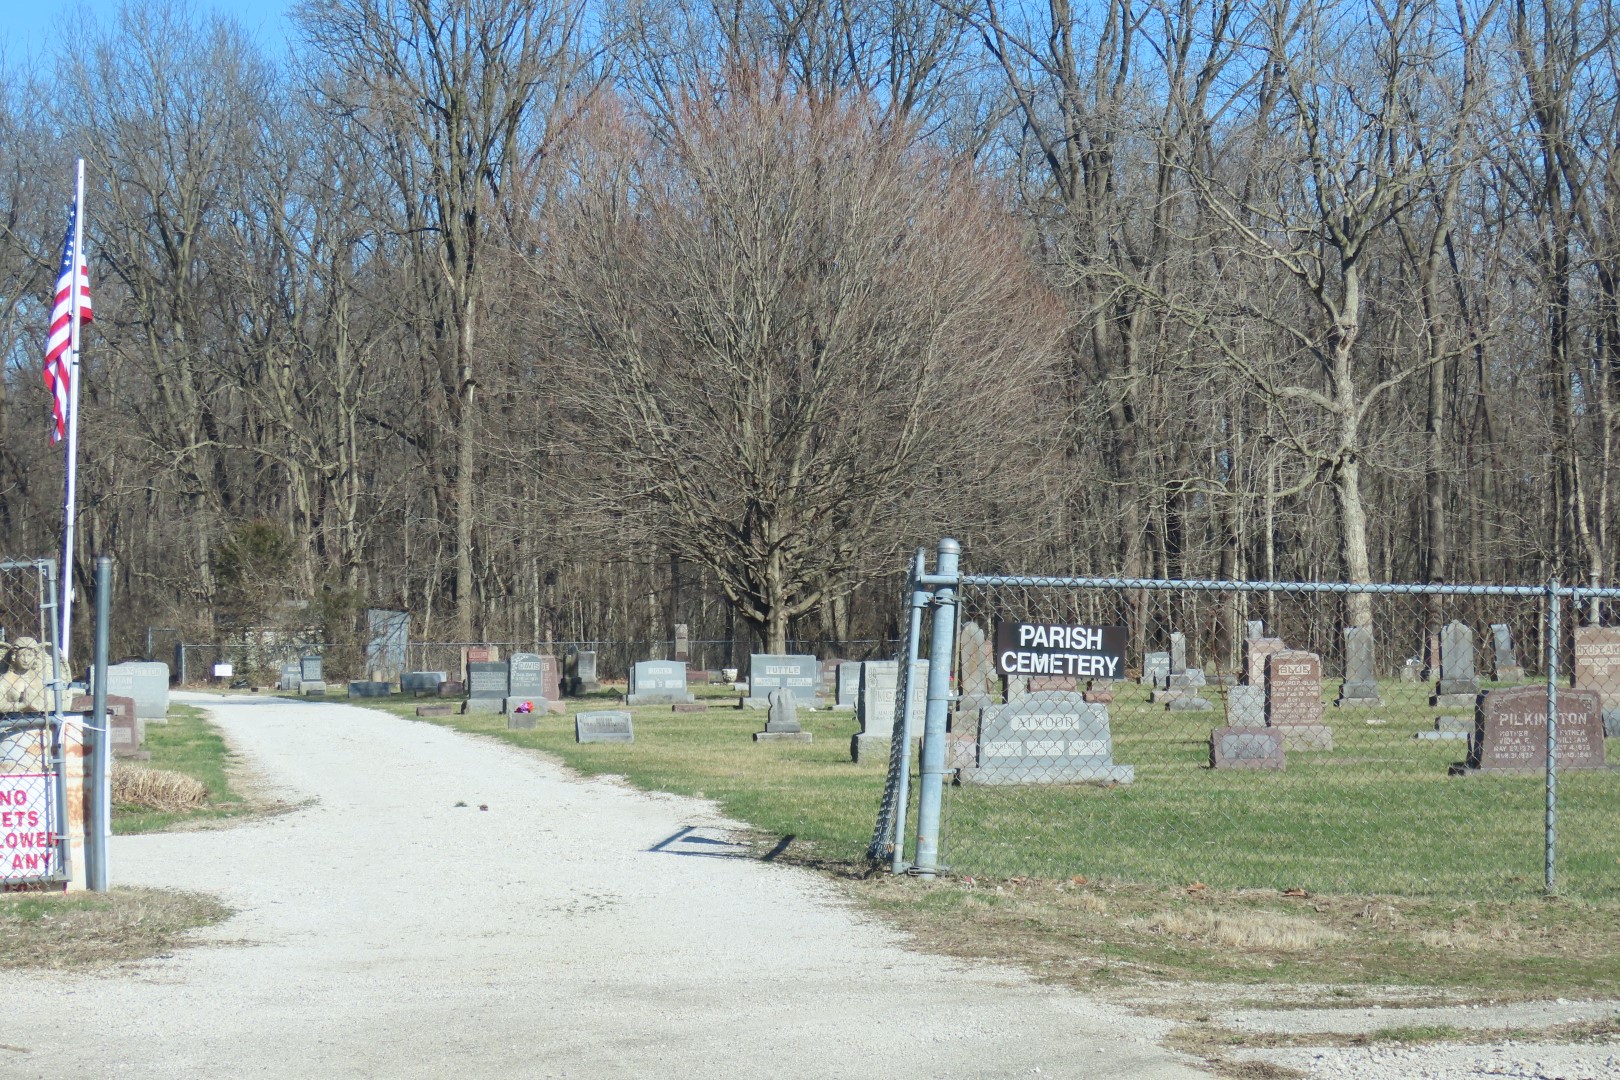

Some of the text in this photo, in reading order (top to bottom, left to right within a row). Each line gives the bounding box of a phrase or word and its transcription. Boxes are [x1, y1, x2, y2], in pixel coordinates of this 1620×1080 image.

[1020, 625, 1102, 650] PARISH
[519, 662, 540, 670] DAVIS
[767, 666, 800, 674] TUTTLE
[1001, 651, 1119, 676] CEMETERY
[1280, 666, 1310, 674] BLUE
[1018, 717, 1073, 727] ATWOOD
[1500, 713, 1587, 726] PILKINTON
[0, 790, 27, 806] NO
[12, 853, 52, 869] ANY
